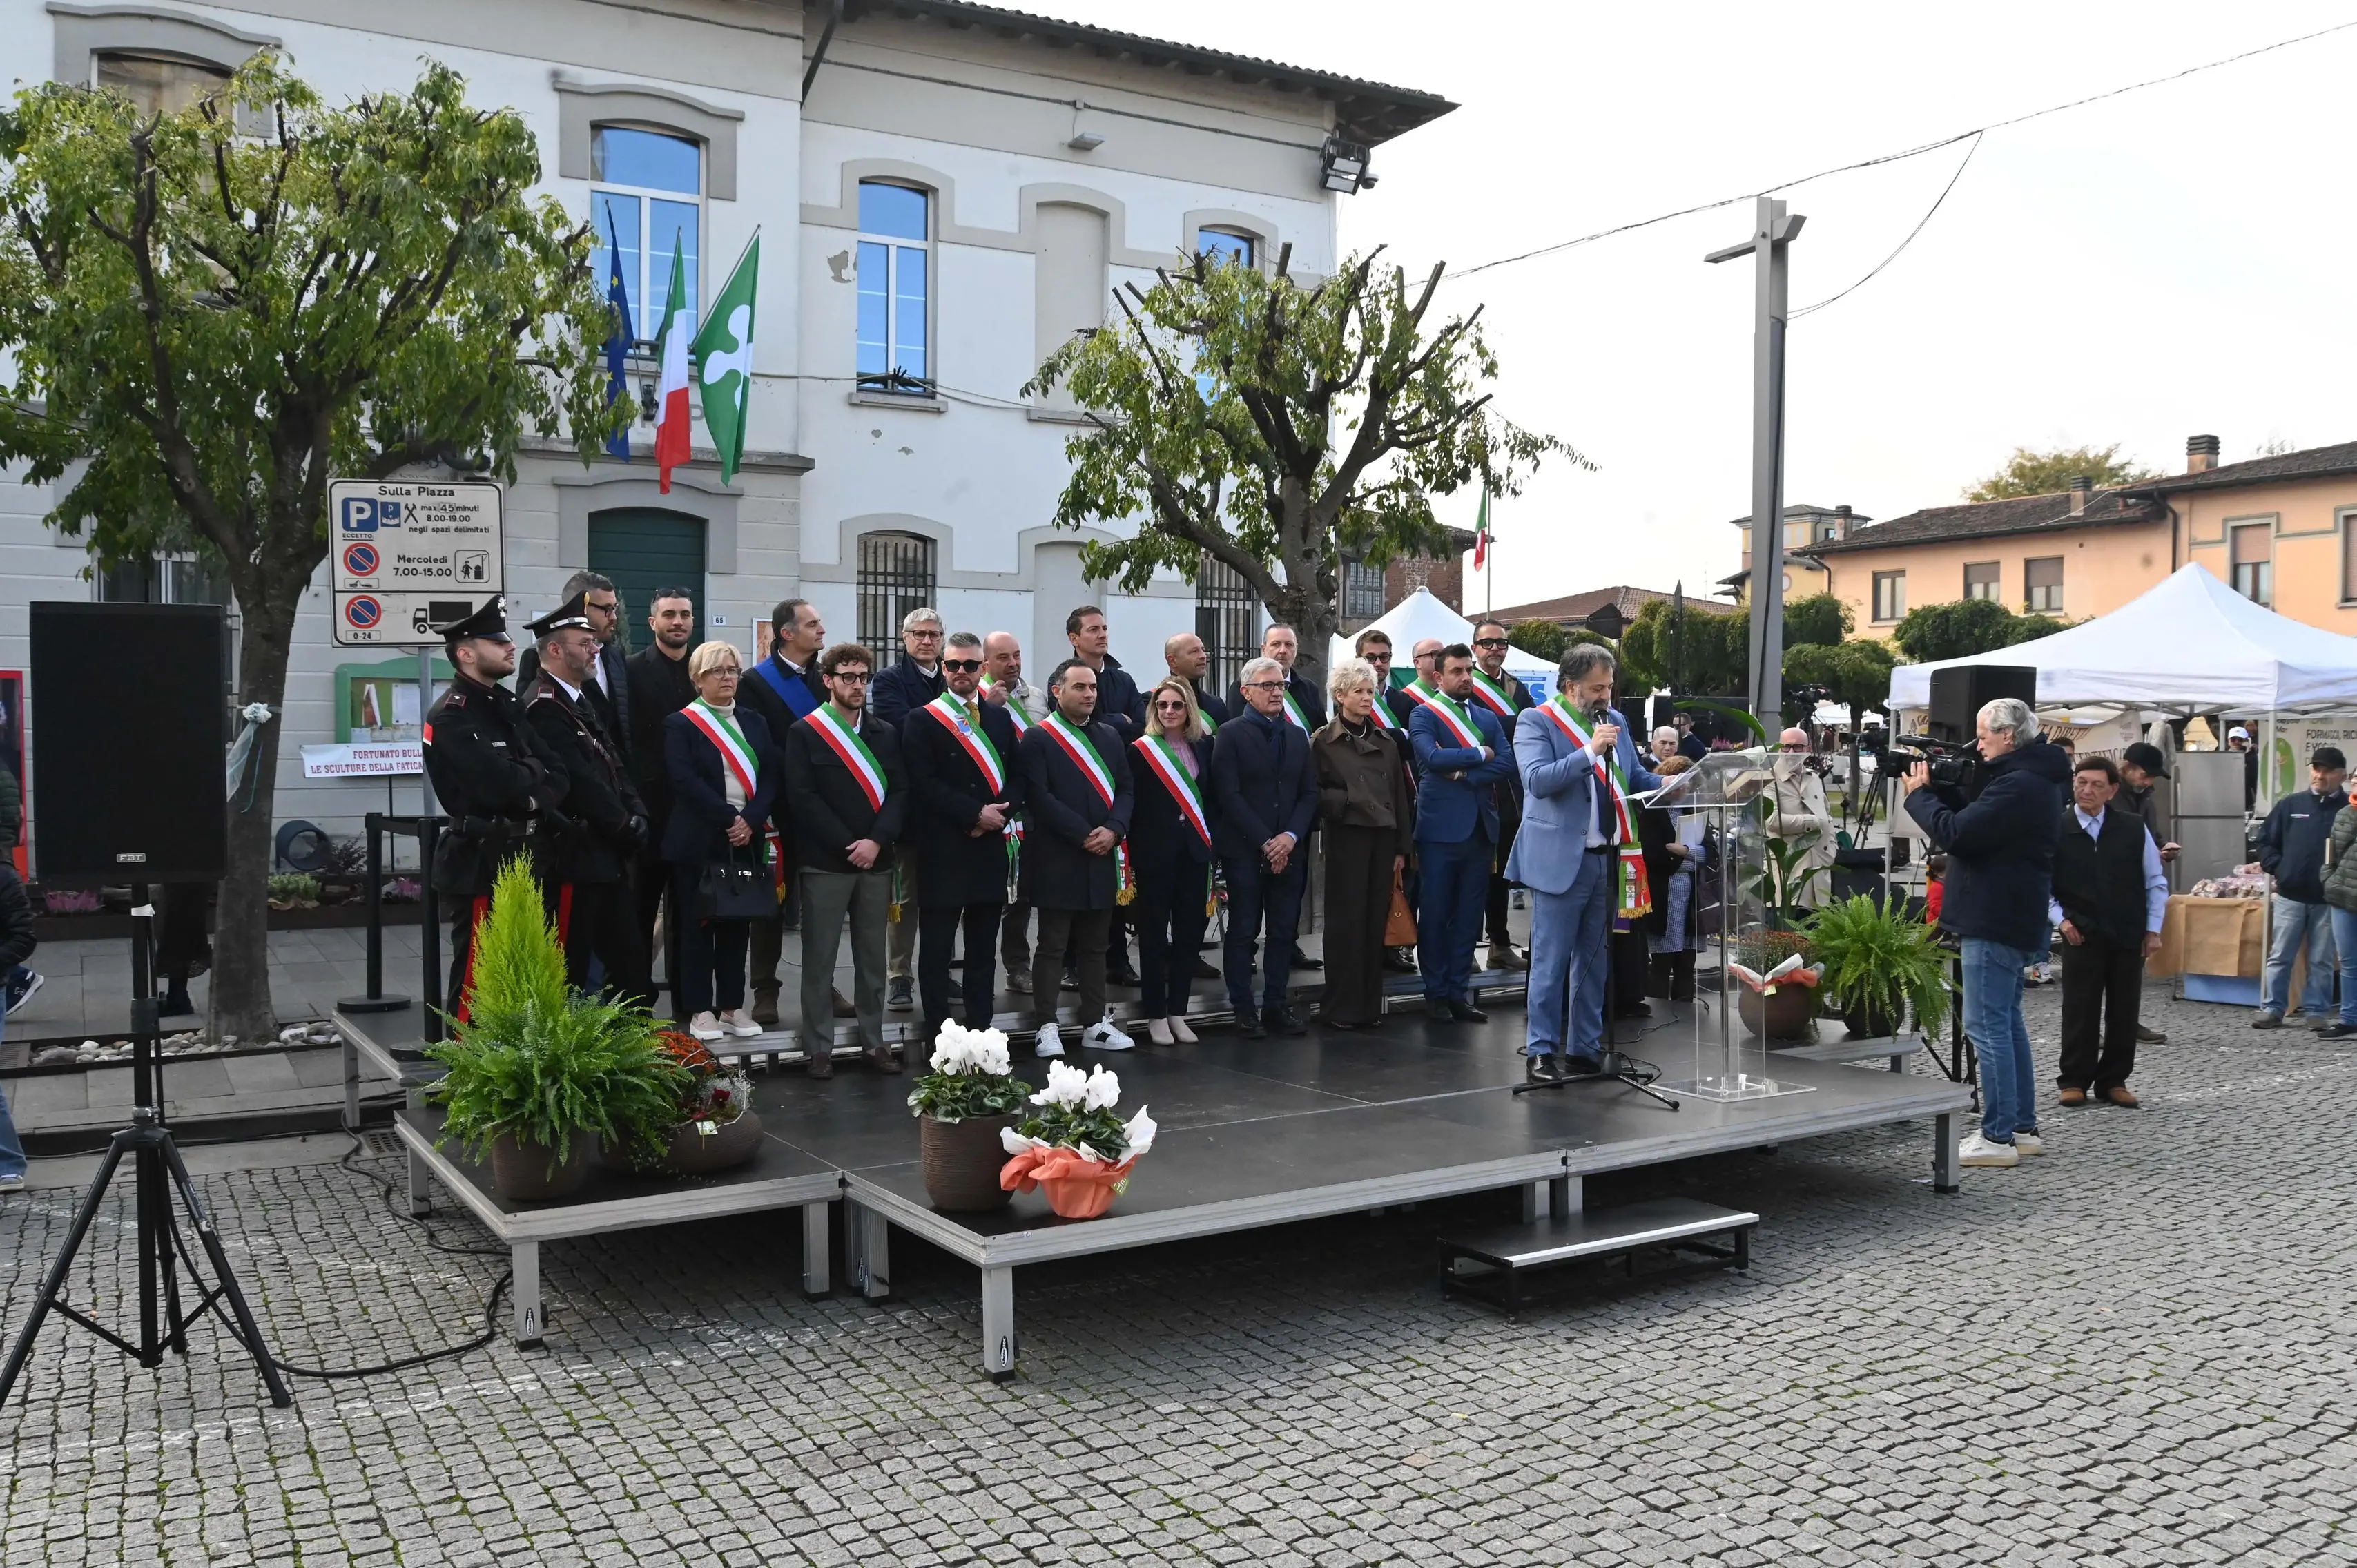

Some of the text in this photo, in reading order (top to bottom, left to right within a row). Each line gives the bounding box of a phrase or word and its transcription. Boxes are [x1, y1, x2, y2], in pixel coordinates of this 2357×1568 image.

[378, 485, 455, 496] Sulla Piazza
[440, 503, 454, 512] 45
[349, 501, 371, 528] P
[393, 567, 452, 577] 7.00-15.00
[353, 749, 400, 759] FORTUNATO
[311, 762, 423, 774] LE SCULTURE DELLA FATICA
